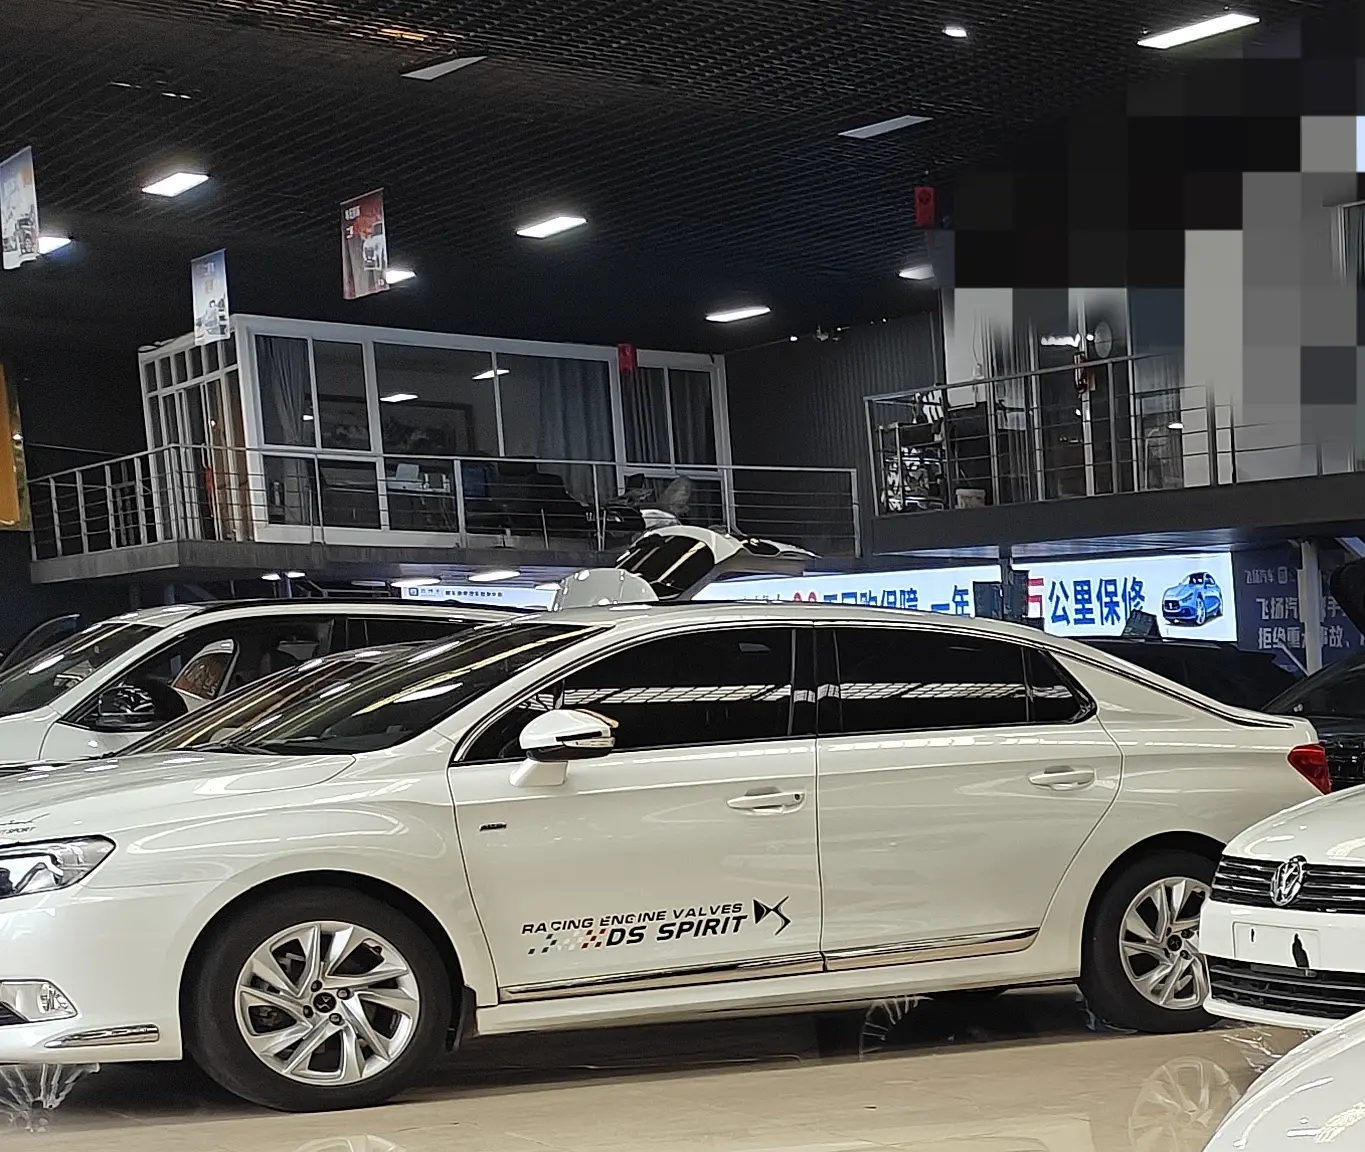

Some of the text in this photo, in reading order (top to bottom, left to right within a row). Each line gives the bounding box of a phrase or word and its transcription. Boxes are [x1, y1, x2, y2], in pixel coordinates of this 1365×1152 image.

[521, 903, 743, 934] RACING ENGINE VALVES
[605, 914, 748, 947] DS SPIRIT
